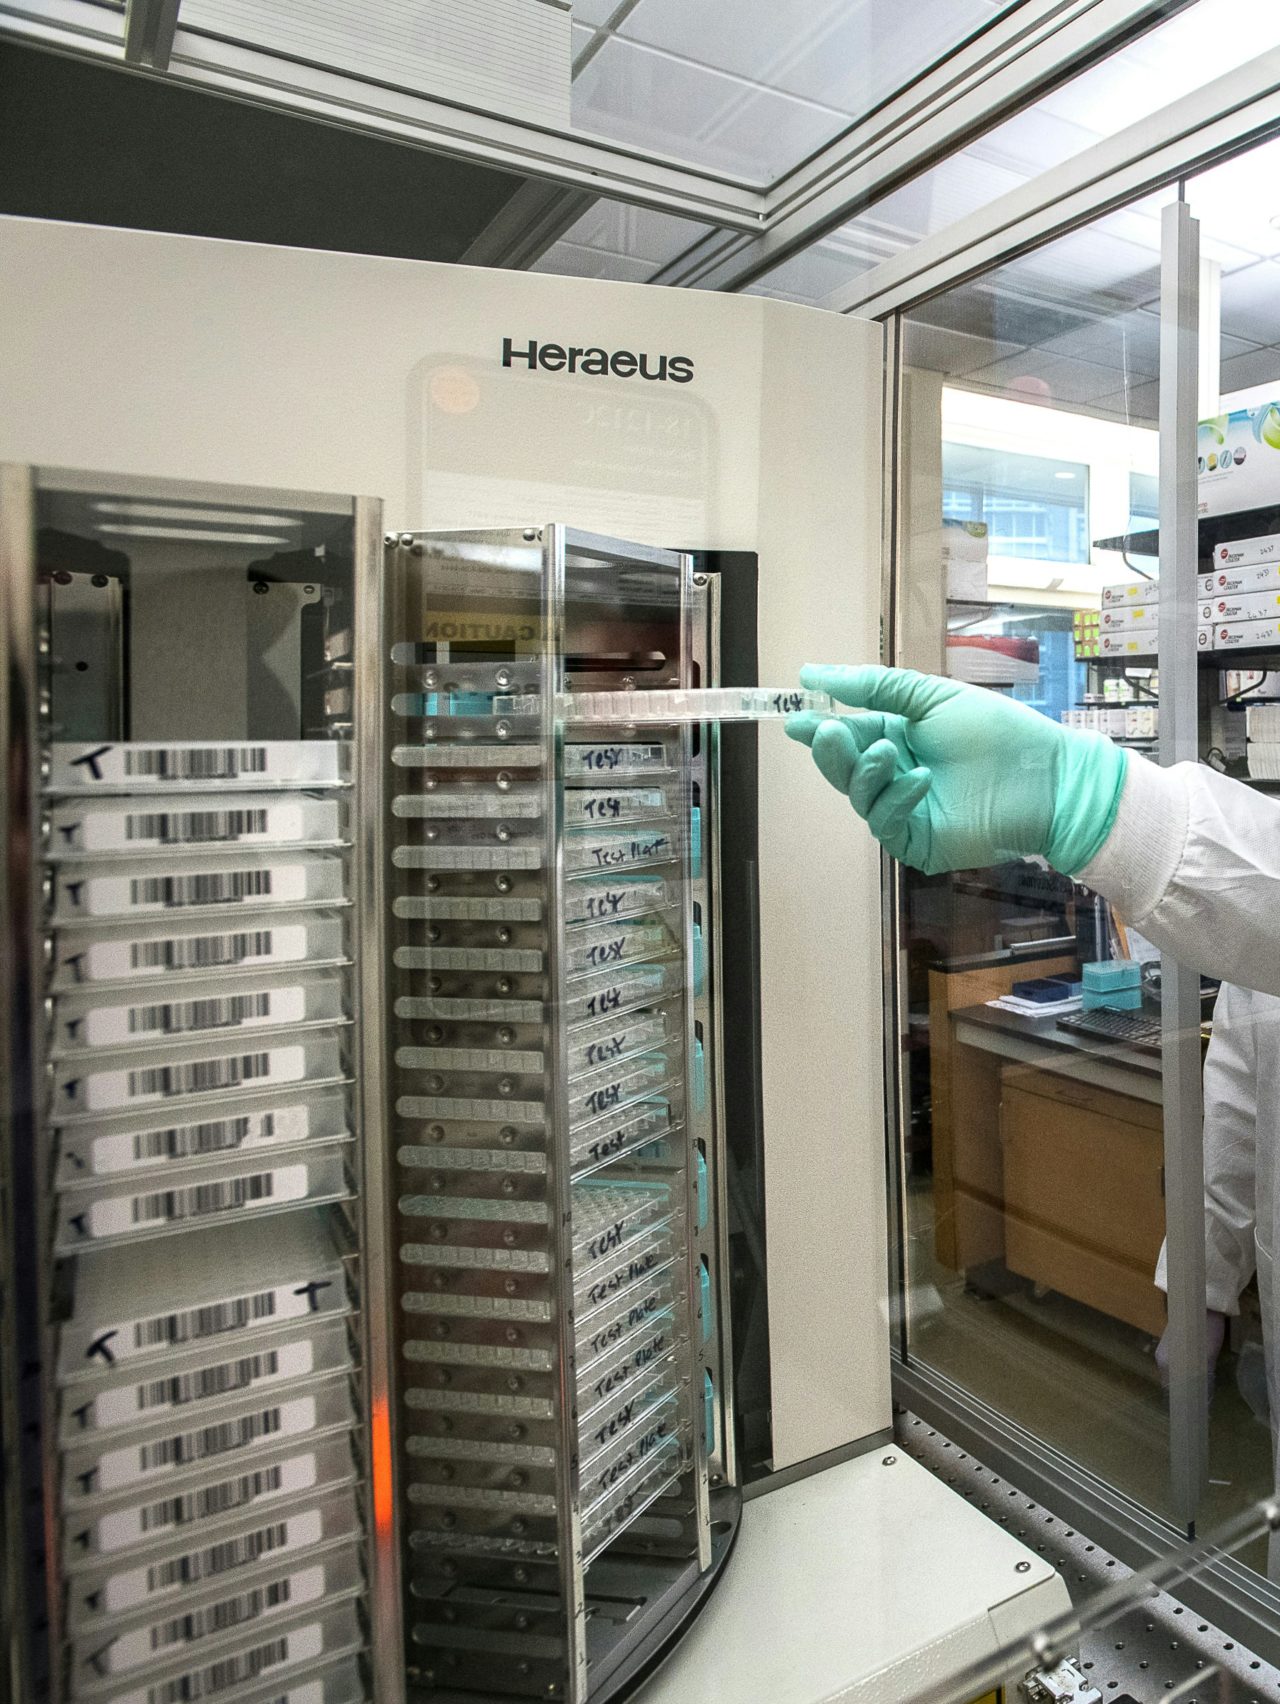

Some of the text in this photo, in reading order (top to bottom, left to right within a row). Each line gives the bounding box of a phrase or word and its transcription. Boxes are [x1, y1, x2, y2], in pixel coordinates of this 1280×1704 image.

[502, 337, 694, 383] Heraeus
[773, 693, 802, 713] Test
[582, 748, 622, 770] Test
[584, 797, 620, 819] Test
[592, 848, 625, 866] Test
[586, 937, 626, 966] Test
[585, 1036, 626, 1065] Test
[584, 1083, 621, 1114] Test
[588, 1131, 625, 1161] Test
[587, 1220, 625, 1260] Test
[588, 1274, 623, 1304] Test
[591, 1322, 622, 1353] Test
[595, 1365, 630, 1398] Test
[594, 1399, 635, 1445] Test
